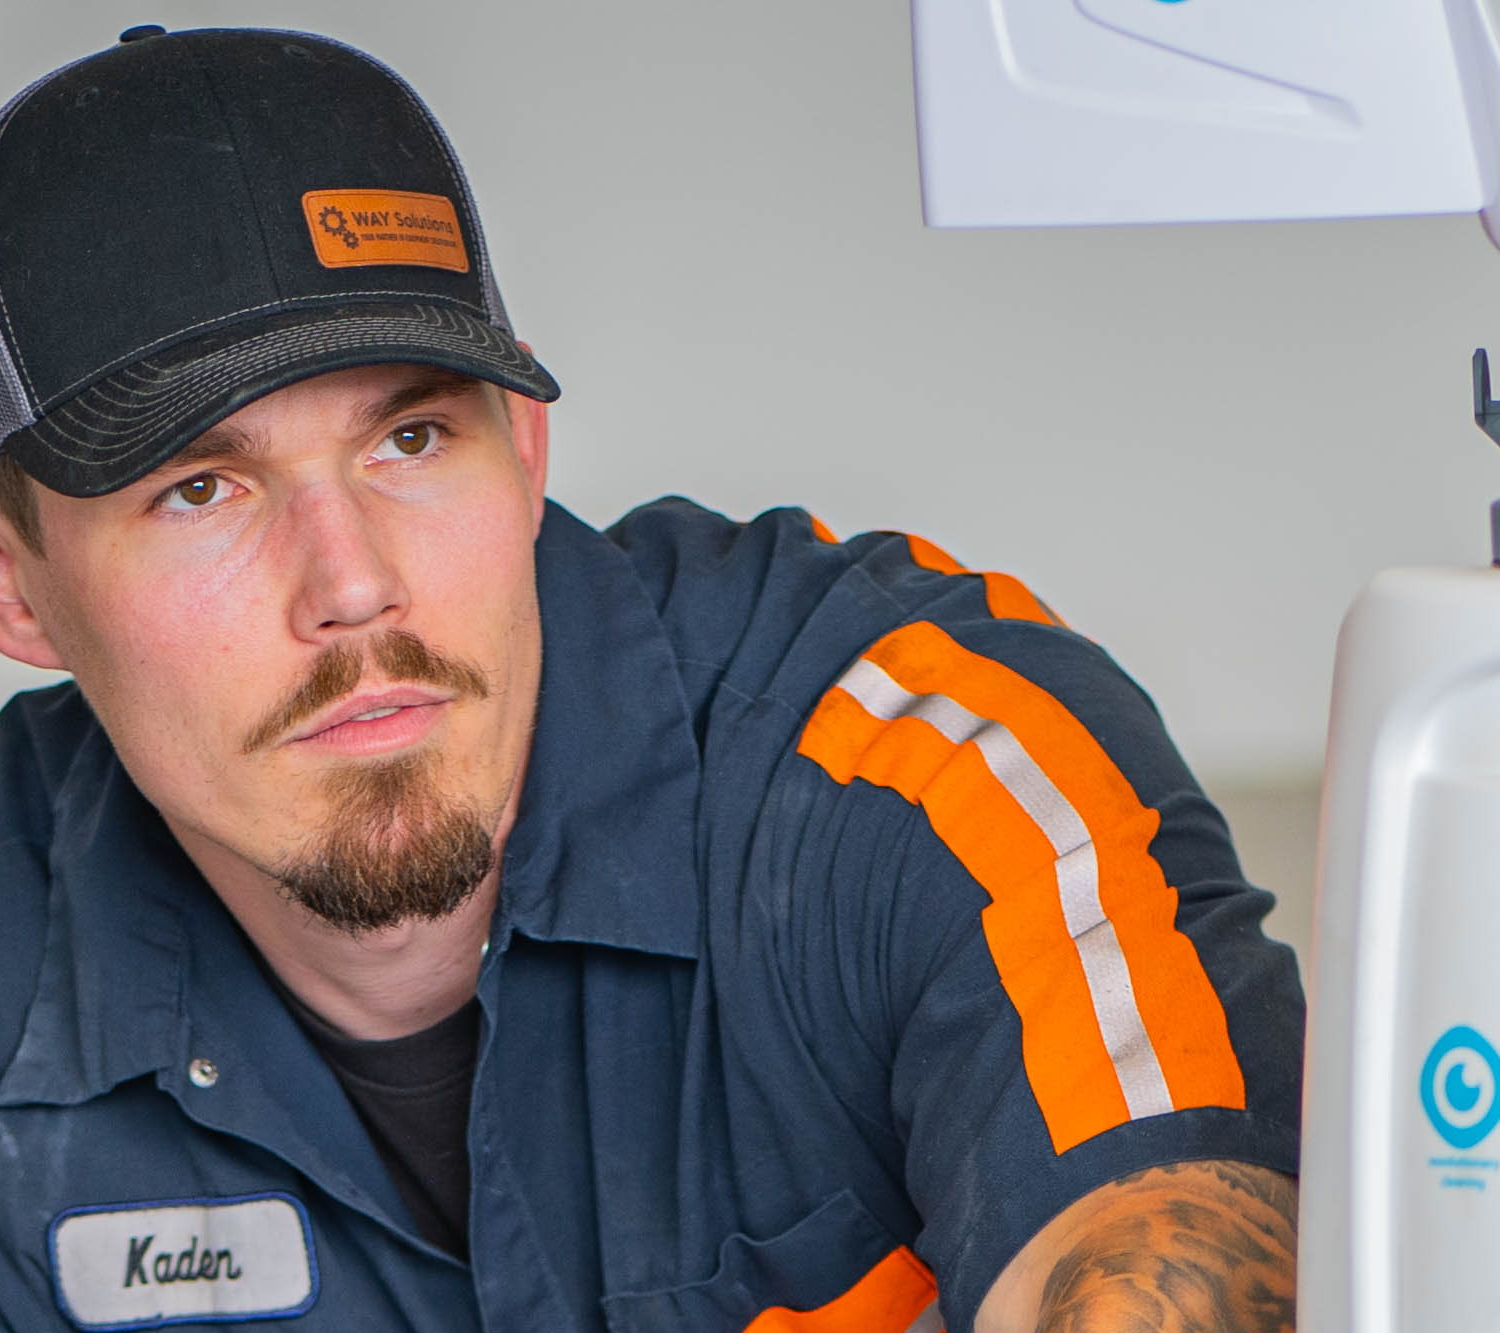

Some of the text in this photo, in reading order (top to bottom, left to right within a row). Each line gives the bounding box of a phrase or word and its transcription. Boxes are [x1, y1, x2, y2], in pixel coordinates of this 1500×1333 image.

[351, 211, 454, 235] WAY Solutions
[123, 1234, 242, 1288] Kaden
